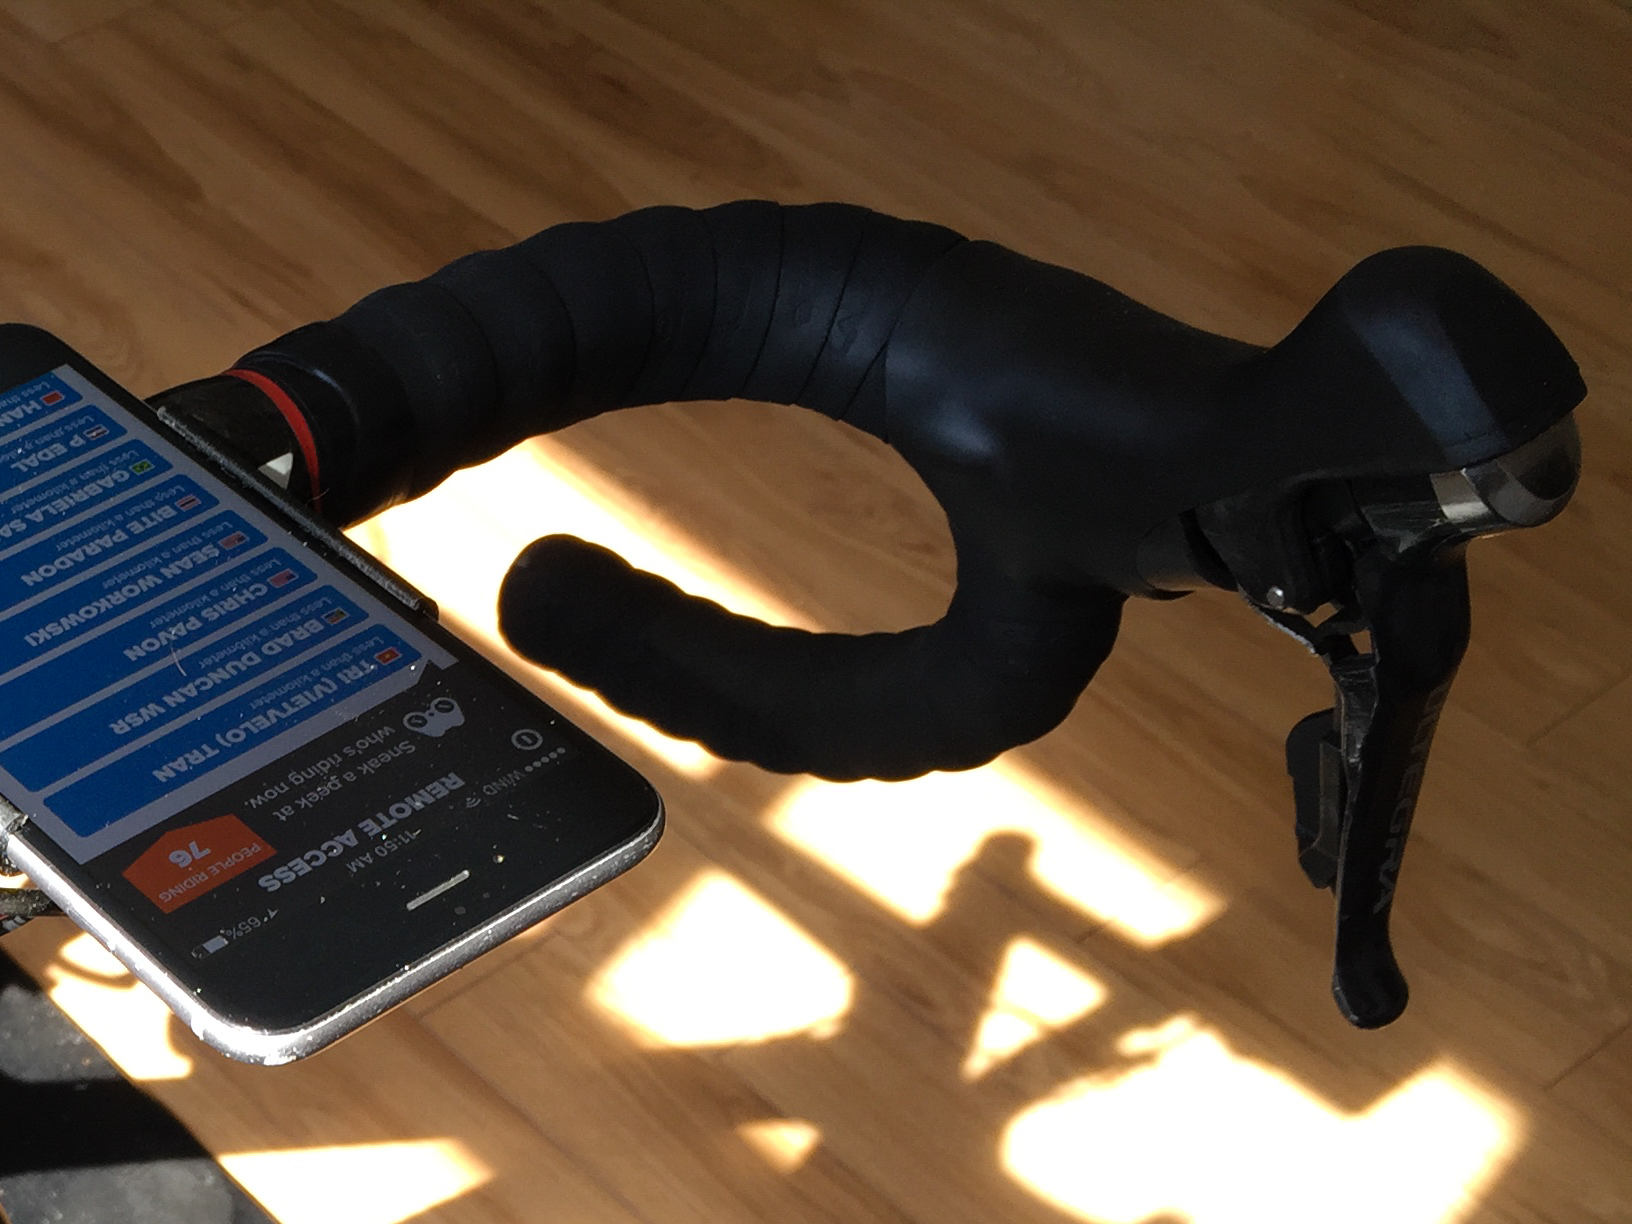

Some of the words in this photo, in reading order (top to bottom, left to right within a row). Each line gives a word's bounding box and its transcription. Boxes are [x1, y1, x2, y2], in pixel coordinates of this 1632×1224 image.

[9, 441, 68, 472] EDAL
[68, 433, 86, 447] P
[23, 468, 130, 523] GABRIELA
[125, 504, 178, 535] BITE
[19, 528, 129, 587] PARADON
[158, 543, 220, 579] SEAN
[23, 573, 163, 647] WORKOWSKI
[199, 582, 268, 621] CHRIS
[122, 614, 203, 662] PAVON
[260, 617, 325, 656] BRAD
[161, 650, 262, 708] DUNCAN
[335, 658, 373, 685] TRI
[108, 702, 166, 735] WSR
[214, 676, 338, 747] (VIETVELO)
[341, 724, 396, 757] who's
[355, 739, 416, 775] Sneak
[151, 742, 220, 783] TRAN
[286, 752, 343, 786] riding
[243, 780, 289, 809] now.
[293, 774, 343, 809] peek
[481, 769, 526, 796] WIND
[271, 804, 295, 822] at
[356, 771, 466, 837] REMOTE
[167, 839, 212, 869] 76
[205, 841, 261, 876] PEOPLE
[257, 827, 359, 893] ACCESS
[373, 829, 417, 857] 11:50
[345, 851, 373, 873] AM
[157, 870, 209, 903] RIDING
[224, 915, 262, 940] 65%
